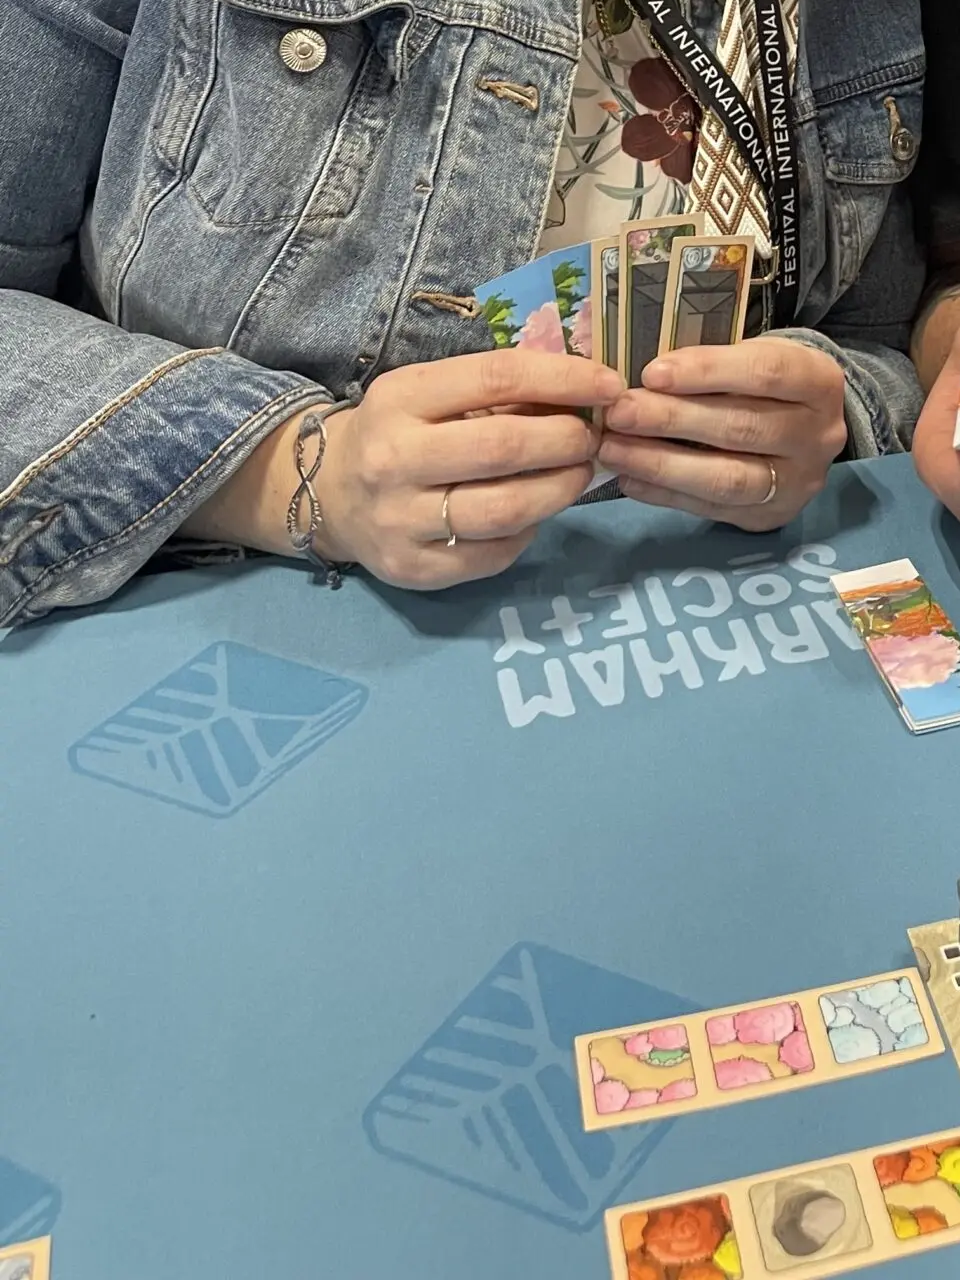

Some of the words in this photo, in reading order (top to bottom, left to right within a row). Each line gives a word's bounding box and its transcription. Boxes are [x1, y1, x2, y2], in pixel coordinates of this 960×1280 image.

[668, 24, 774, 183] INTERNATIONAL
[758, 4, 797, 180] INTERNATIONAL
[781, 187, 797, 287] FESTIVAL
